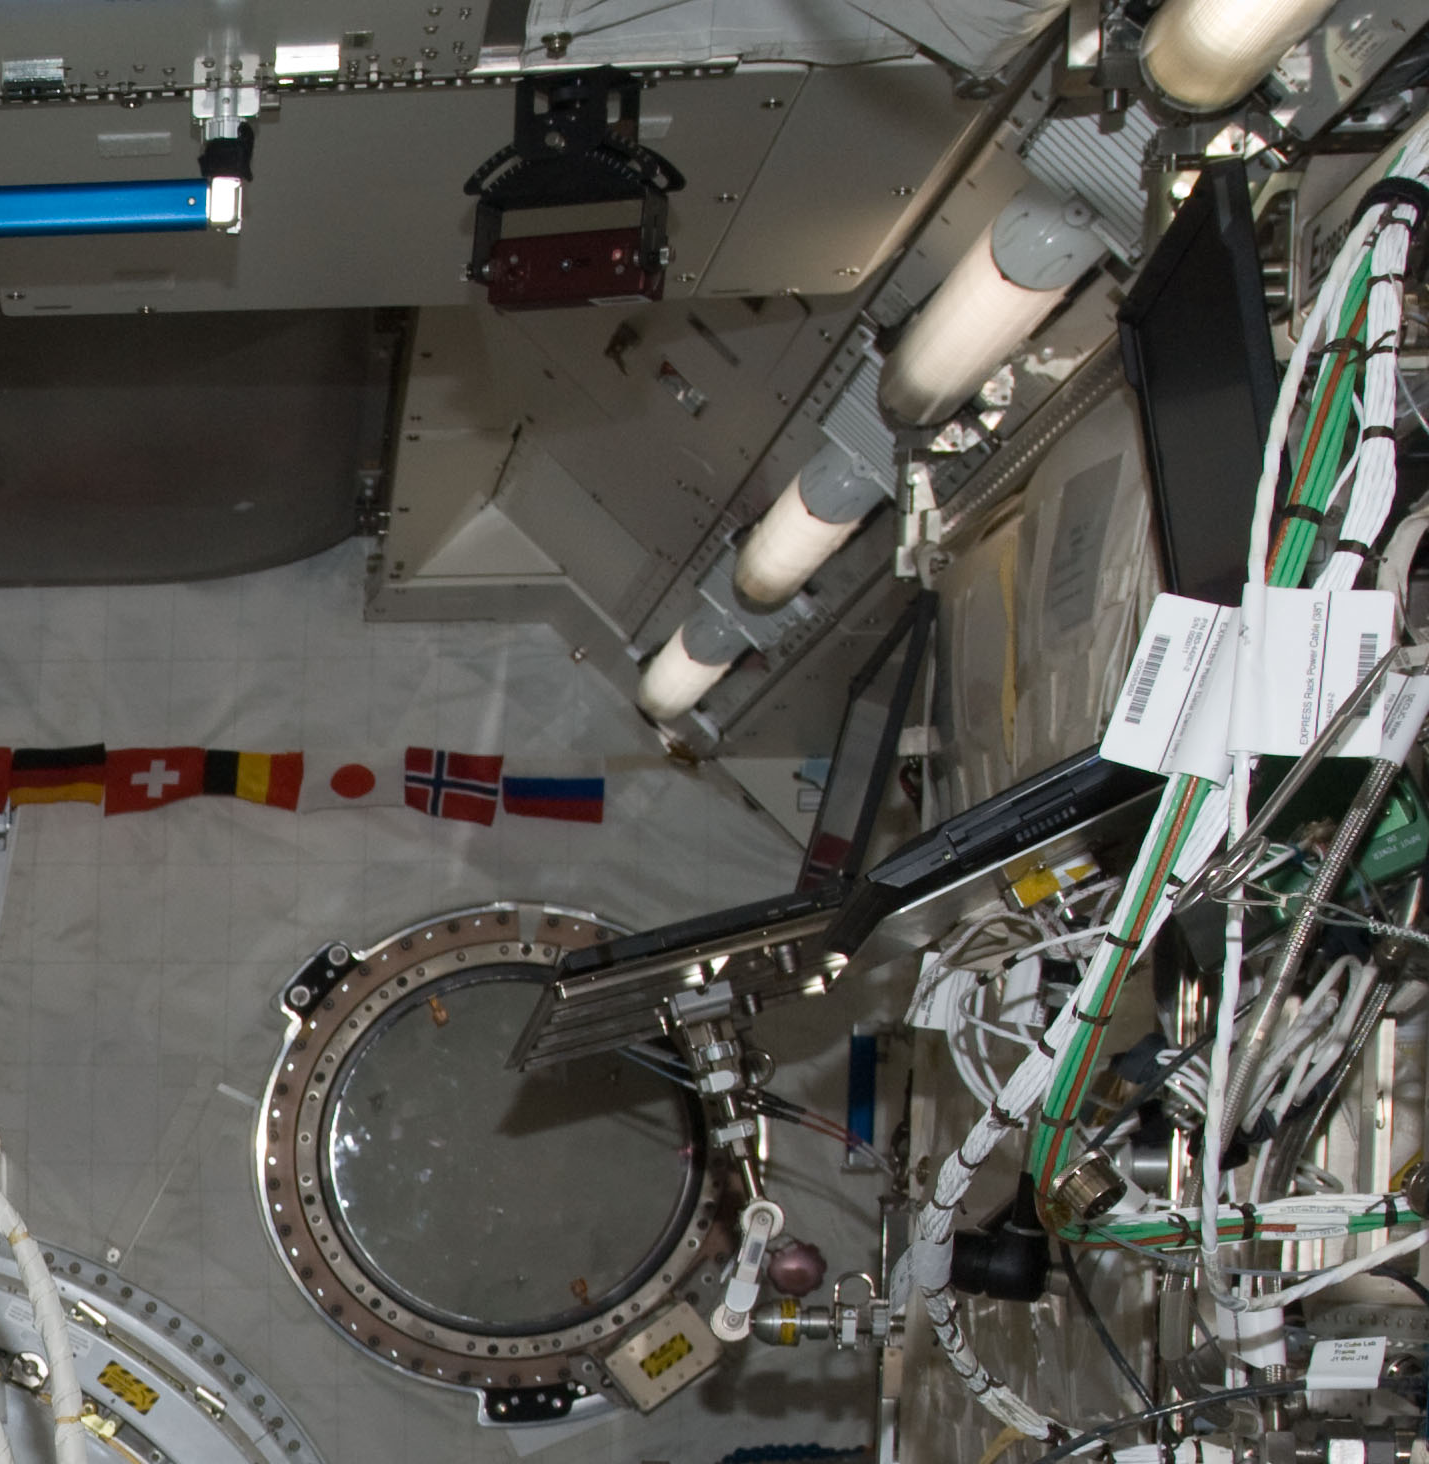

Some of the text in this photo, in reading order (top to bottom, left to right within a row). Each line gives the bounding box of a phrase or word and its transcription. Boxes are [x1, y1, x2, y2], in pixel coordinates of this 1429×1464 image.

[1310, 623, 1321, 648] Cable
[1307, 650, 1318, 675] Power
[1304, 678, 1315, 699] Rack
[1300, 701, 1312, 745] EXPRESS
